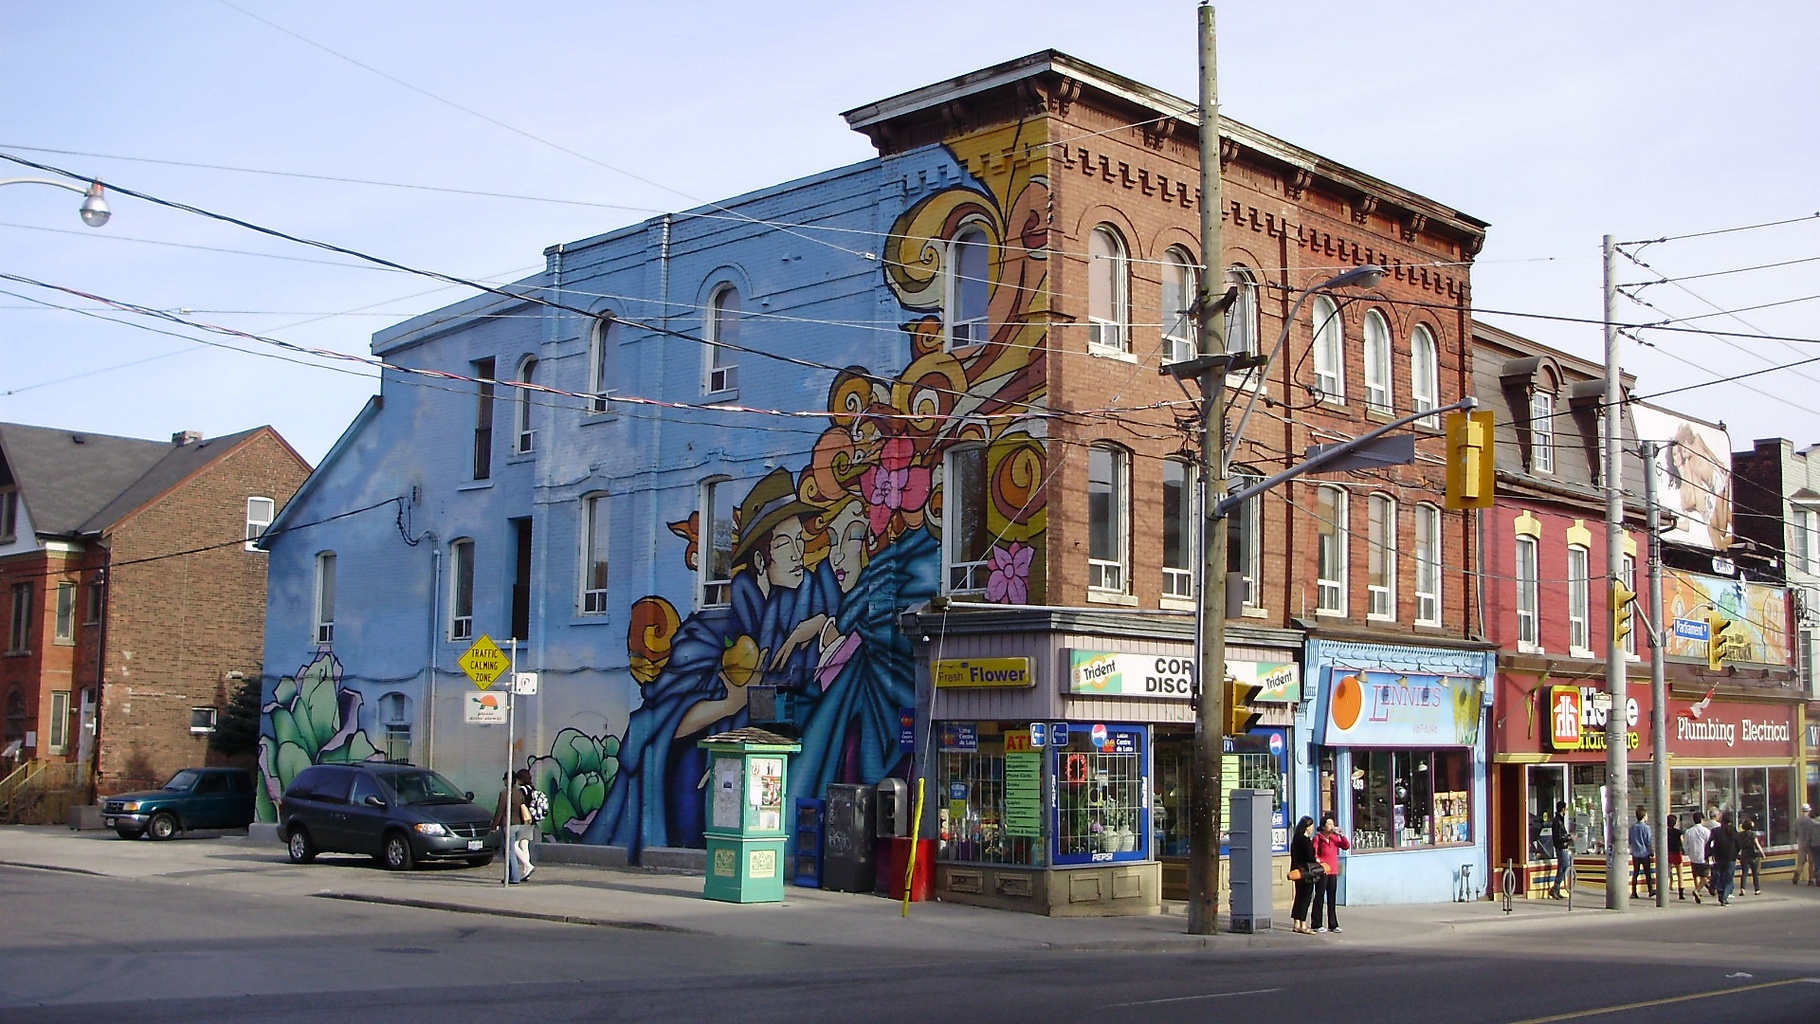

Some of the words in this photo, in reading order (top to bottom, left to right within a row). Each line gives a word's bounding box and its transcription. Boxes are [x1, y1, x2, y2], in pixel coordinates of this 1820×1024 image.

[1676, 620, 1703, 636] Parliament
[471, 648, 498, 658] TRAFFIC
[470, 660, 498, 670] CALMING
[1083, 660, 1116, 680] Trident
[475, 672, 491, 682] ZONE
[938, 671, 964, 682] Fresh
[969, 666, 1025, 682] Flower
[1266, 671, 1293, 690] Trident
[1369, 685, 1442, 721] LENNIE'S
[1580, 686, 1639, 726] Hoe
[1677, 716, 1735, 747] Plumbing
[1741, 719, 1790, 741] Electrical
[1006, 735, 1031, 750] AT
[1091, 852, 1113, 862] PEPSI
